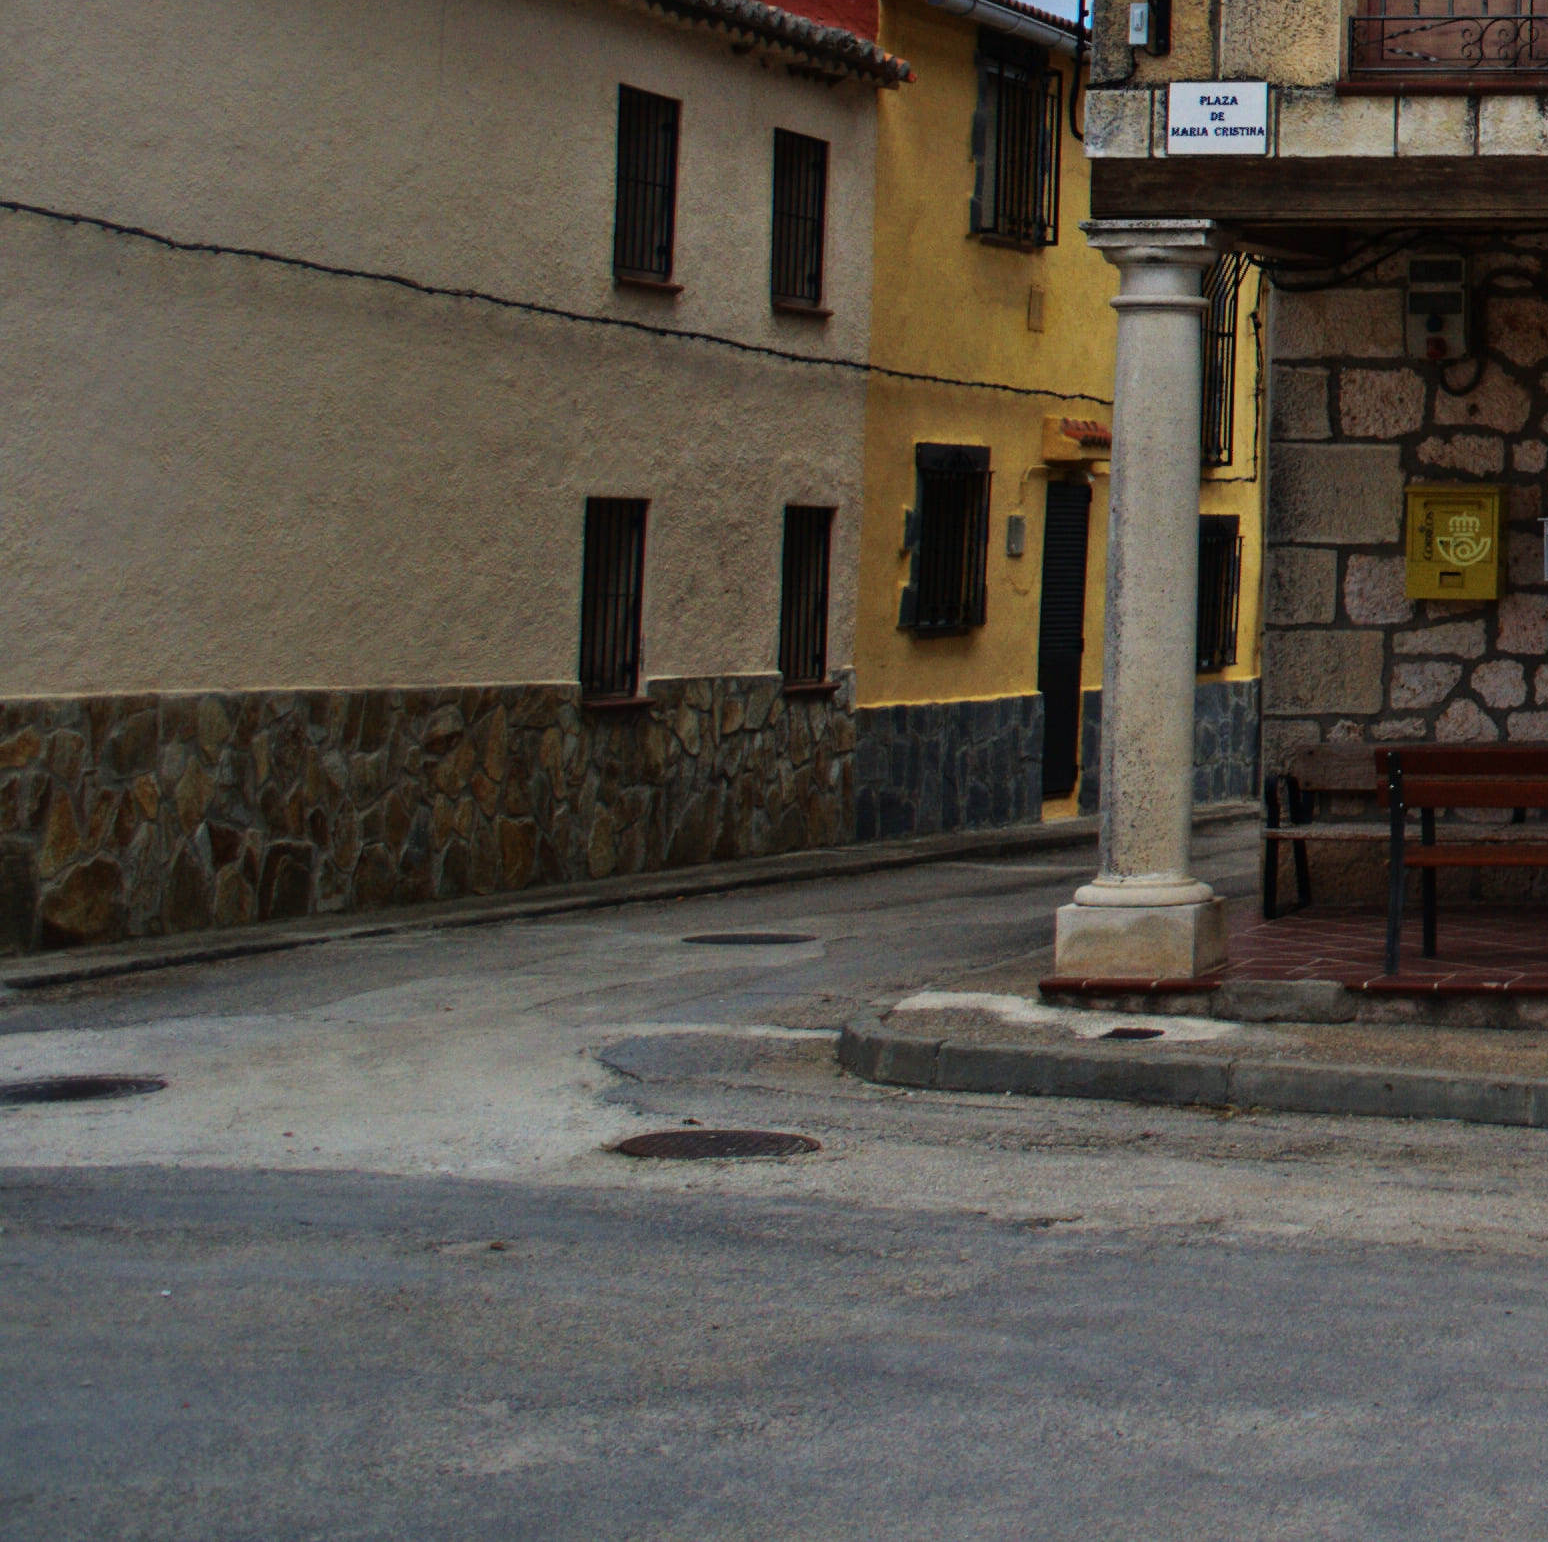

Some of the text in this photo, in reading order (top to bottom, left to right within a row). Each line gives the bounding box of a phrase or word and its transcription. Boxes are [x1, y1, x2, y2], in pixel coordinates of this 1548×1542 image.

[1200, 96, 1239, 105] PLAZA
[1210, 112, 1225, 121] DE
[1171, 127, 1265, 136] MARIA CRISTINA
